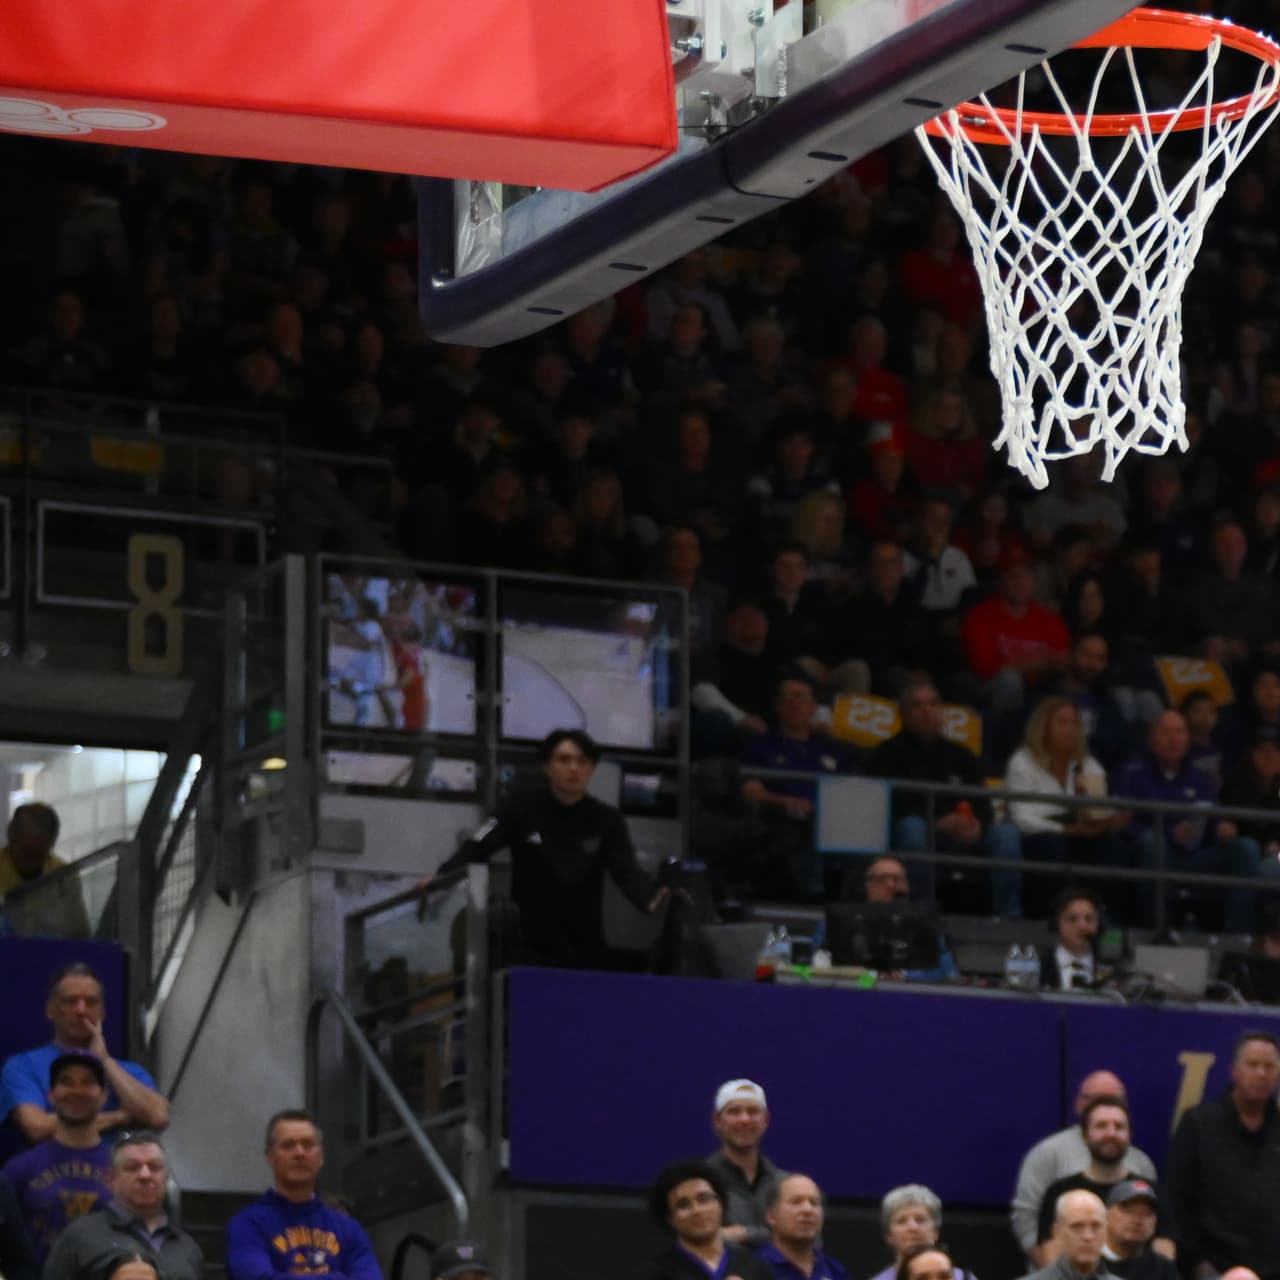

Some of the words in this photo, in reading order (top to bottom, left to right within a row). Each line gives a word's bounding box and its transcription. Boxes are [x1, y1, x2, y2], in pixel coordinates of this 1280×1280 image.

[127, 533, 184, 677] 8
[848, 696, 896, 740] 22
[943, 706, 969, 740] 2
